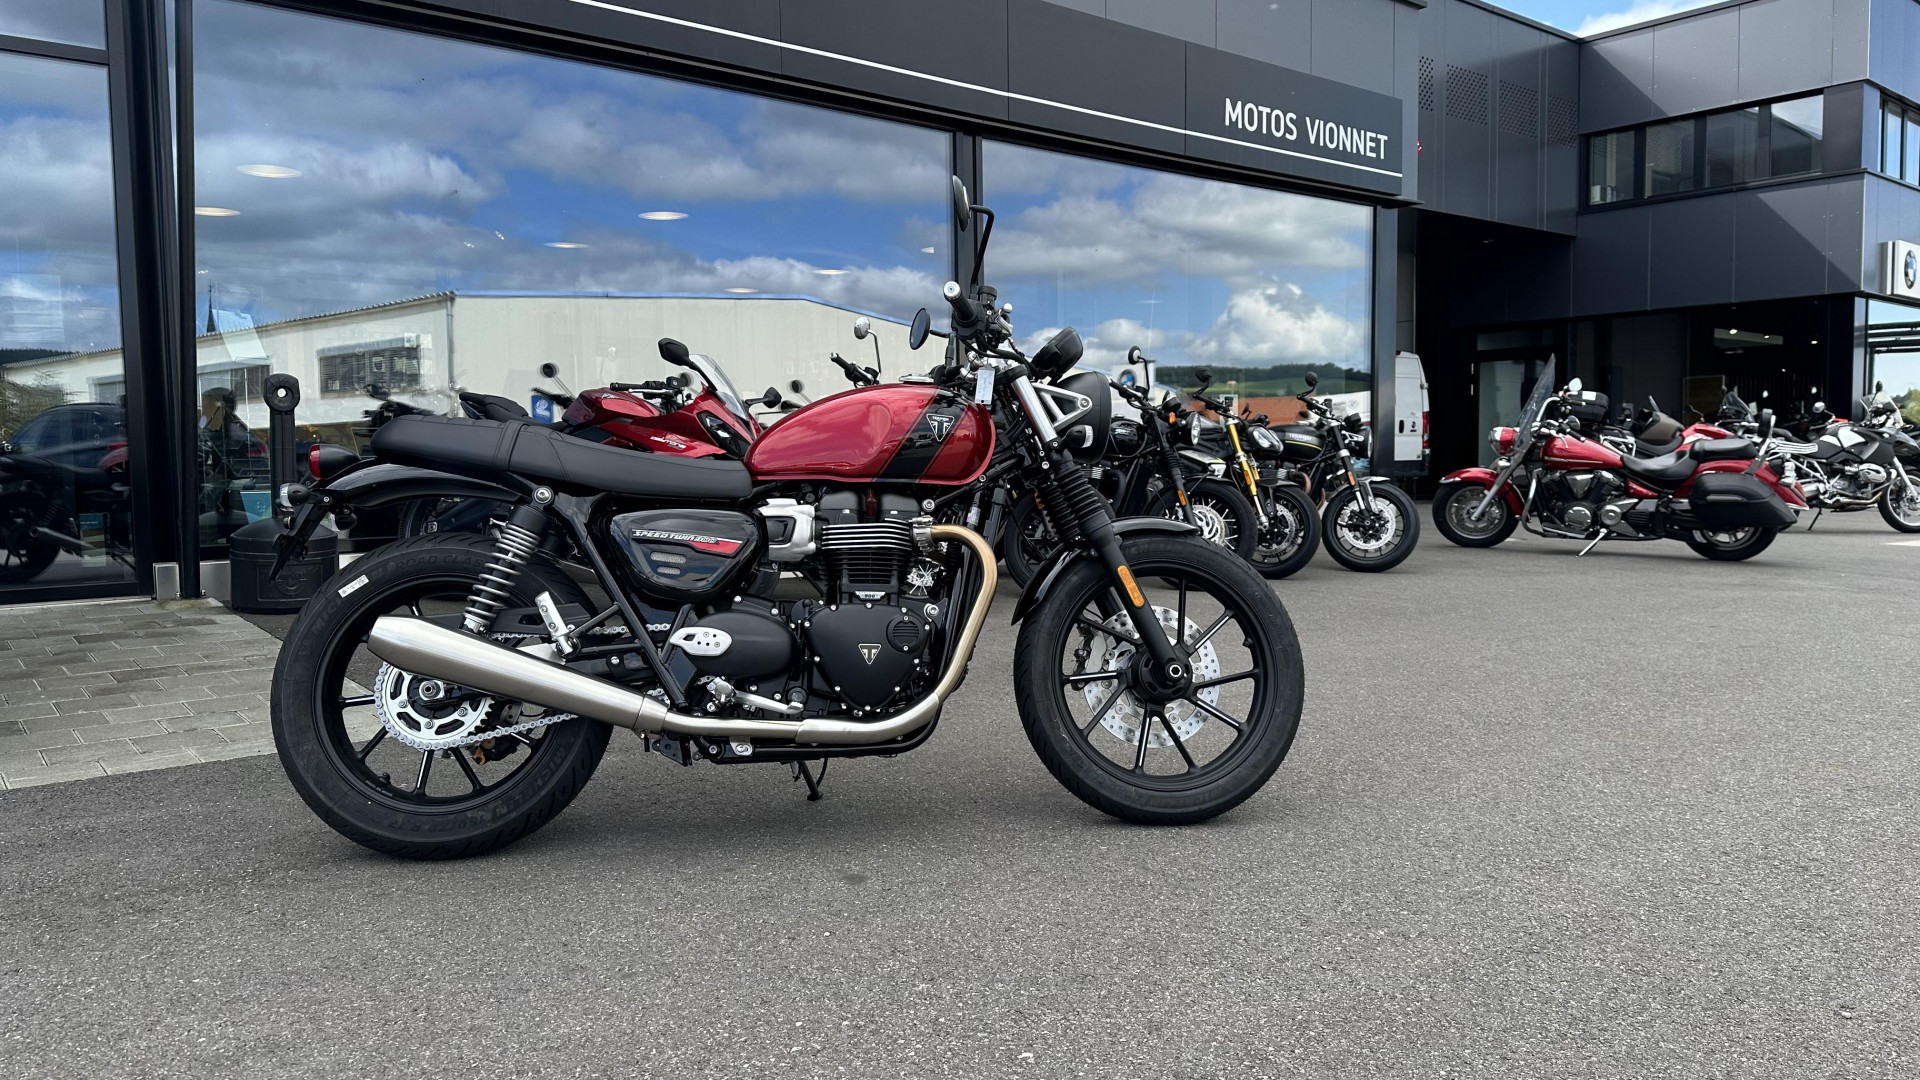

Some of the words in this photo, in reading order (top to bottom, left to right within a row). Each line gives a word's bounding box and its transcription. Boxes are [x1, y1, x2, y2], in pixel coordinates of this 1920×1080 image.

[1225, 98, 1298, 141] MOTOS
[1305, 116, 1389, 160] VIONNET
[632, 530, 667, 539] SPEED
[669, 533, 695, 541] TWIN
